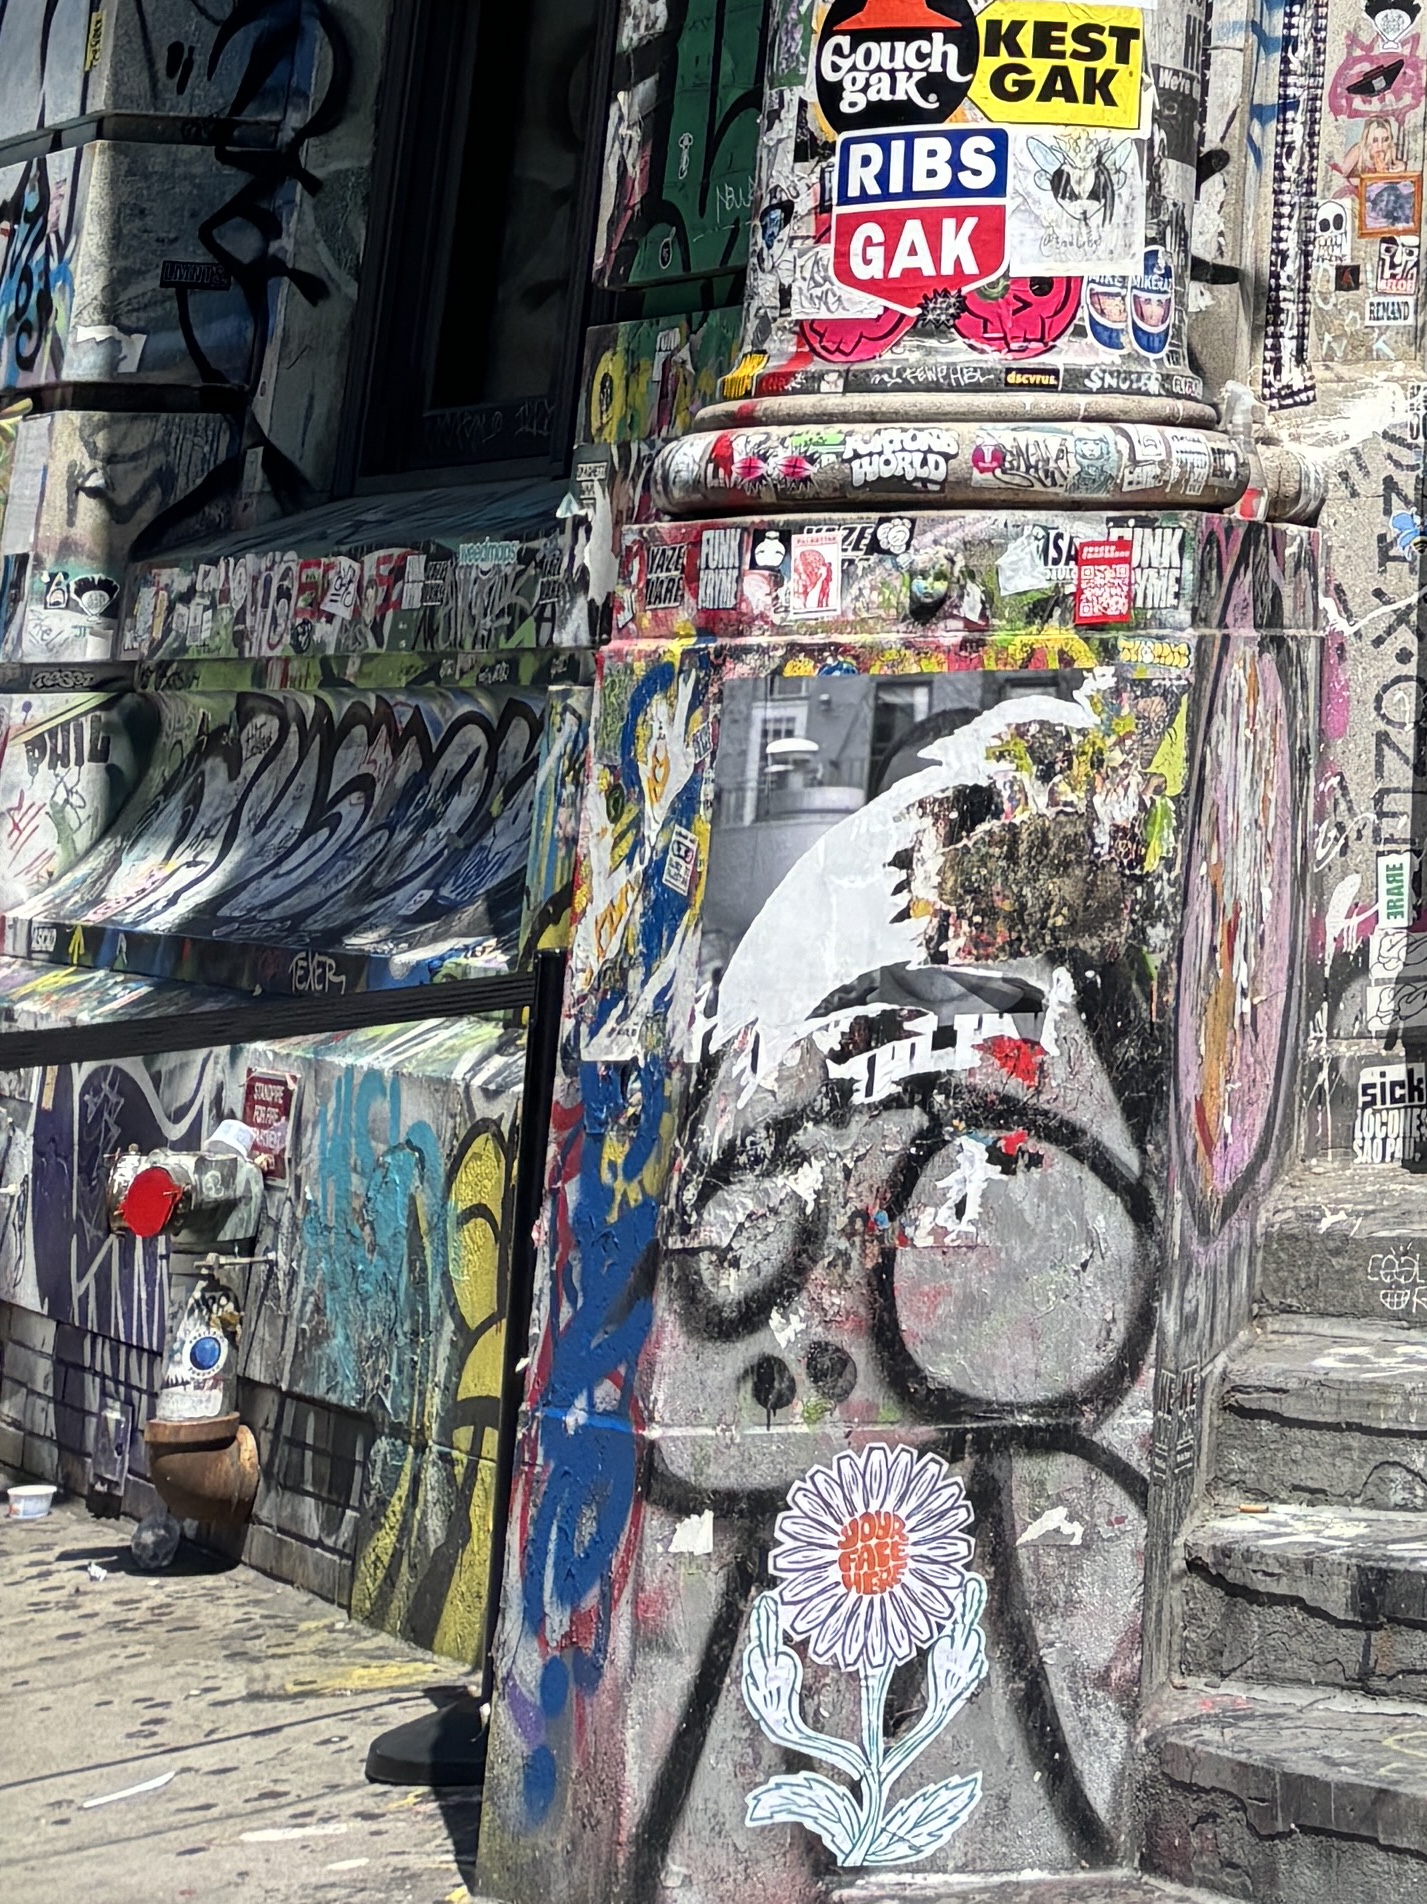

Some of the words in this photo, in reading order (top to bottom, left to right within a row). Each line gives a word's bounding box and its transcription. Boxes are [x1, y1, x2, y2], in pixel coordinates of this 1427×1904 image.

[983, 19, 1141, 65] KEST
[988, 63, 1119, 107] GAK
[846, 135, 998, 197] RIBS
[848, 217, 981, 280] GAK
[1368, 301, 1411, 322] REMAND
[850, 451, 948, 487] WORLD
[1360, 1069, 1425, 1109] sick
